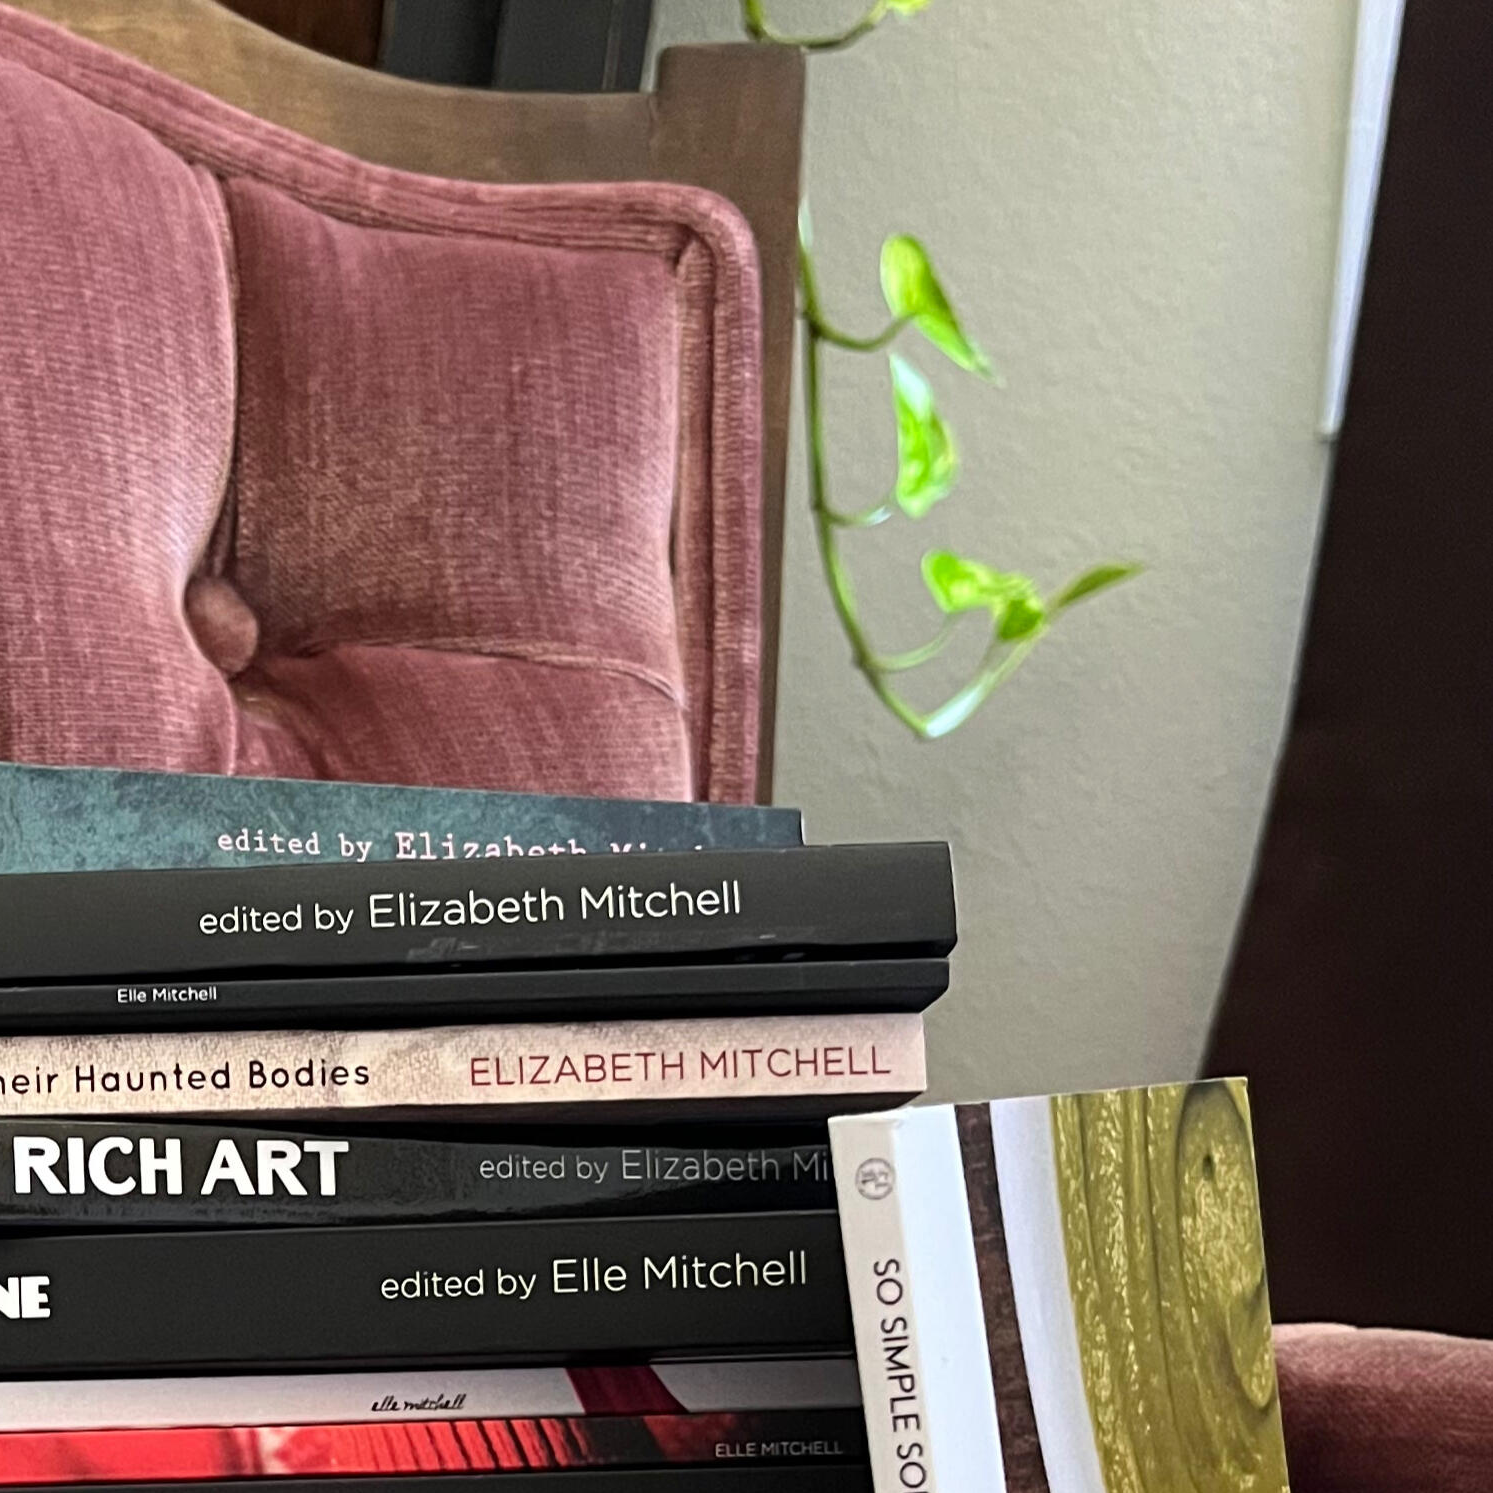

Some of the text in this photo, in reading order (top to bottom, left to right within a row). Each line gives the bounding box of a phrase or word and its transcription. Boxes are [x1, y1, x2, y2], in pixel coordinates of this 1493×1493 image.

[217, 831, 320, 856] edited
[338, 833, 372, 863] by
[199, 880, 742, 935] edited by Elizabeth Mitchell
[117, 986, 217, 1003] Elle Mitchell
[74, 1063, 231, 1093] Haunted
[248, 1057, 371, 1087] Bodies
[469, 1045, 892, 1086] ELIZABETH MITCHELL
[13, 1135, 182, 1196] RICH
[200, 1139, 349, 1196] ART
[479, 1155, 565, 1180] edited
[575, 1154, 610, 1186] by
[622, 1150, 780, 1180] Elizabeth
[380, 1250, 808, 1300] edited by Elle Mitchell
[874, 1258, 904, 1305] SO
[880, 1317, 921, 1433] SIMPLE
[371, 1393, 467, 1411] elle mitchell
[715, 1441, 843, 1457] ELLE MITCHELL
